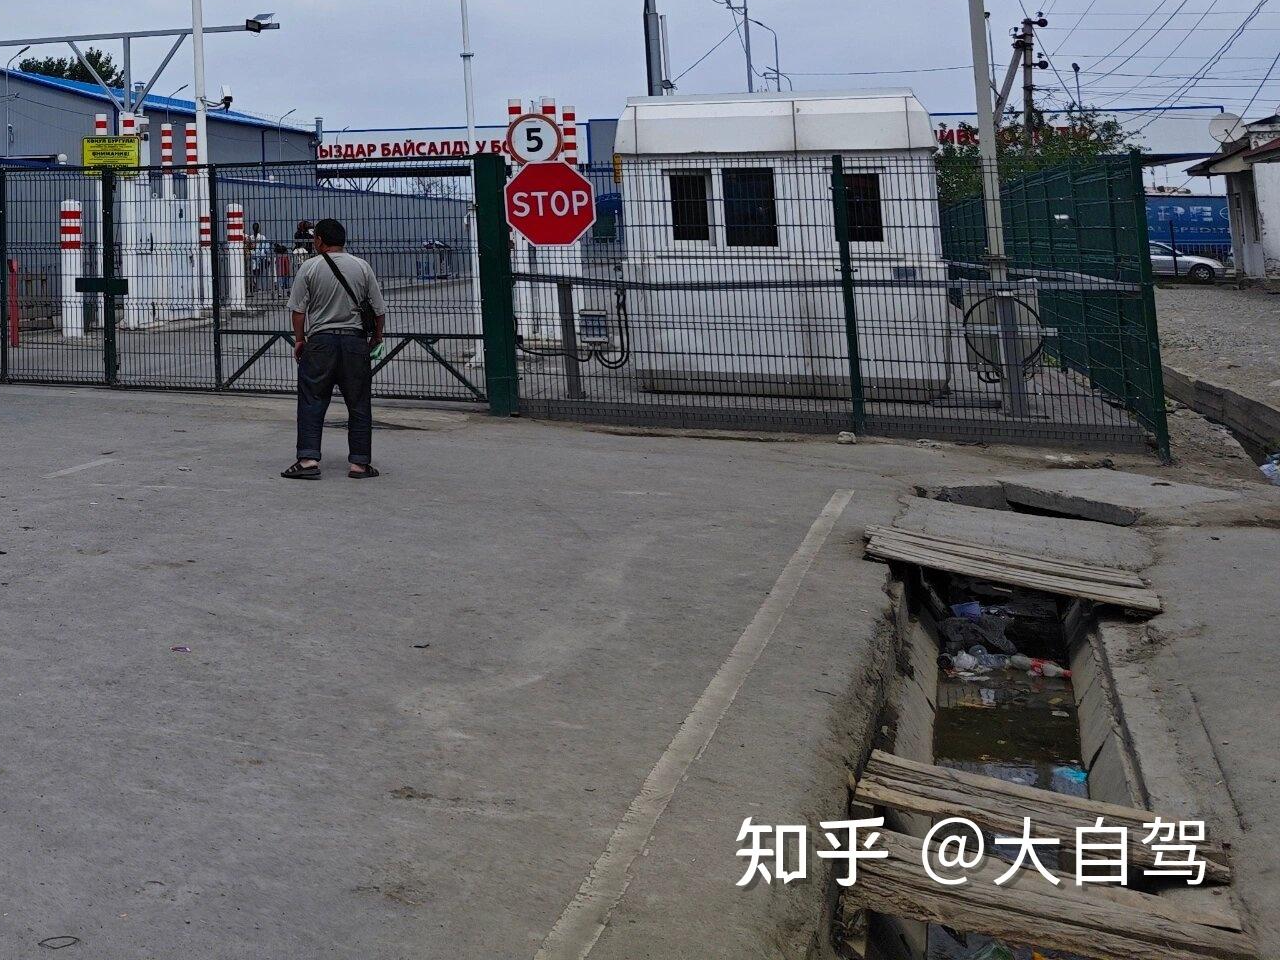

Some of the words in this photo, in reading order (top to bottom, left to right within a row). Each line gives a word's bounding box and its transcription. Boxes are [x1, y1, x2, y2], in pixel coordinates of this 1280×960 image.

[316, 143, 378, 160] ЫЗДАР
[526, 127, 544, 153] 5
[512, 190, 589, 218] STOP
